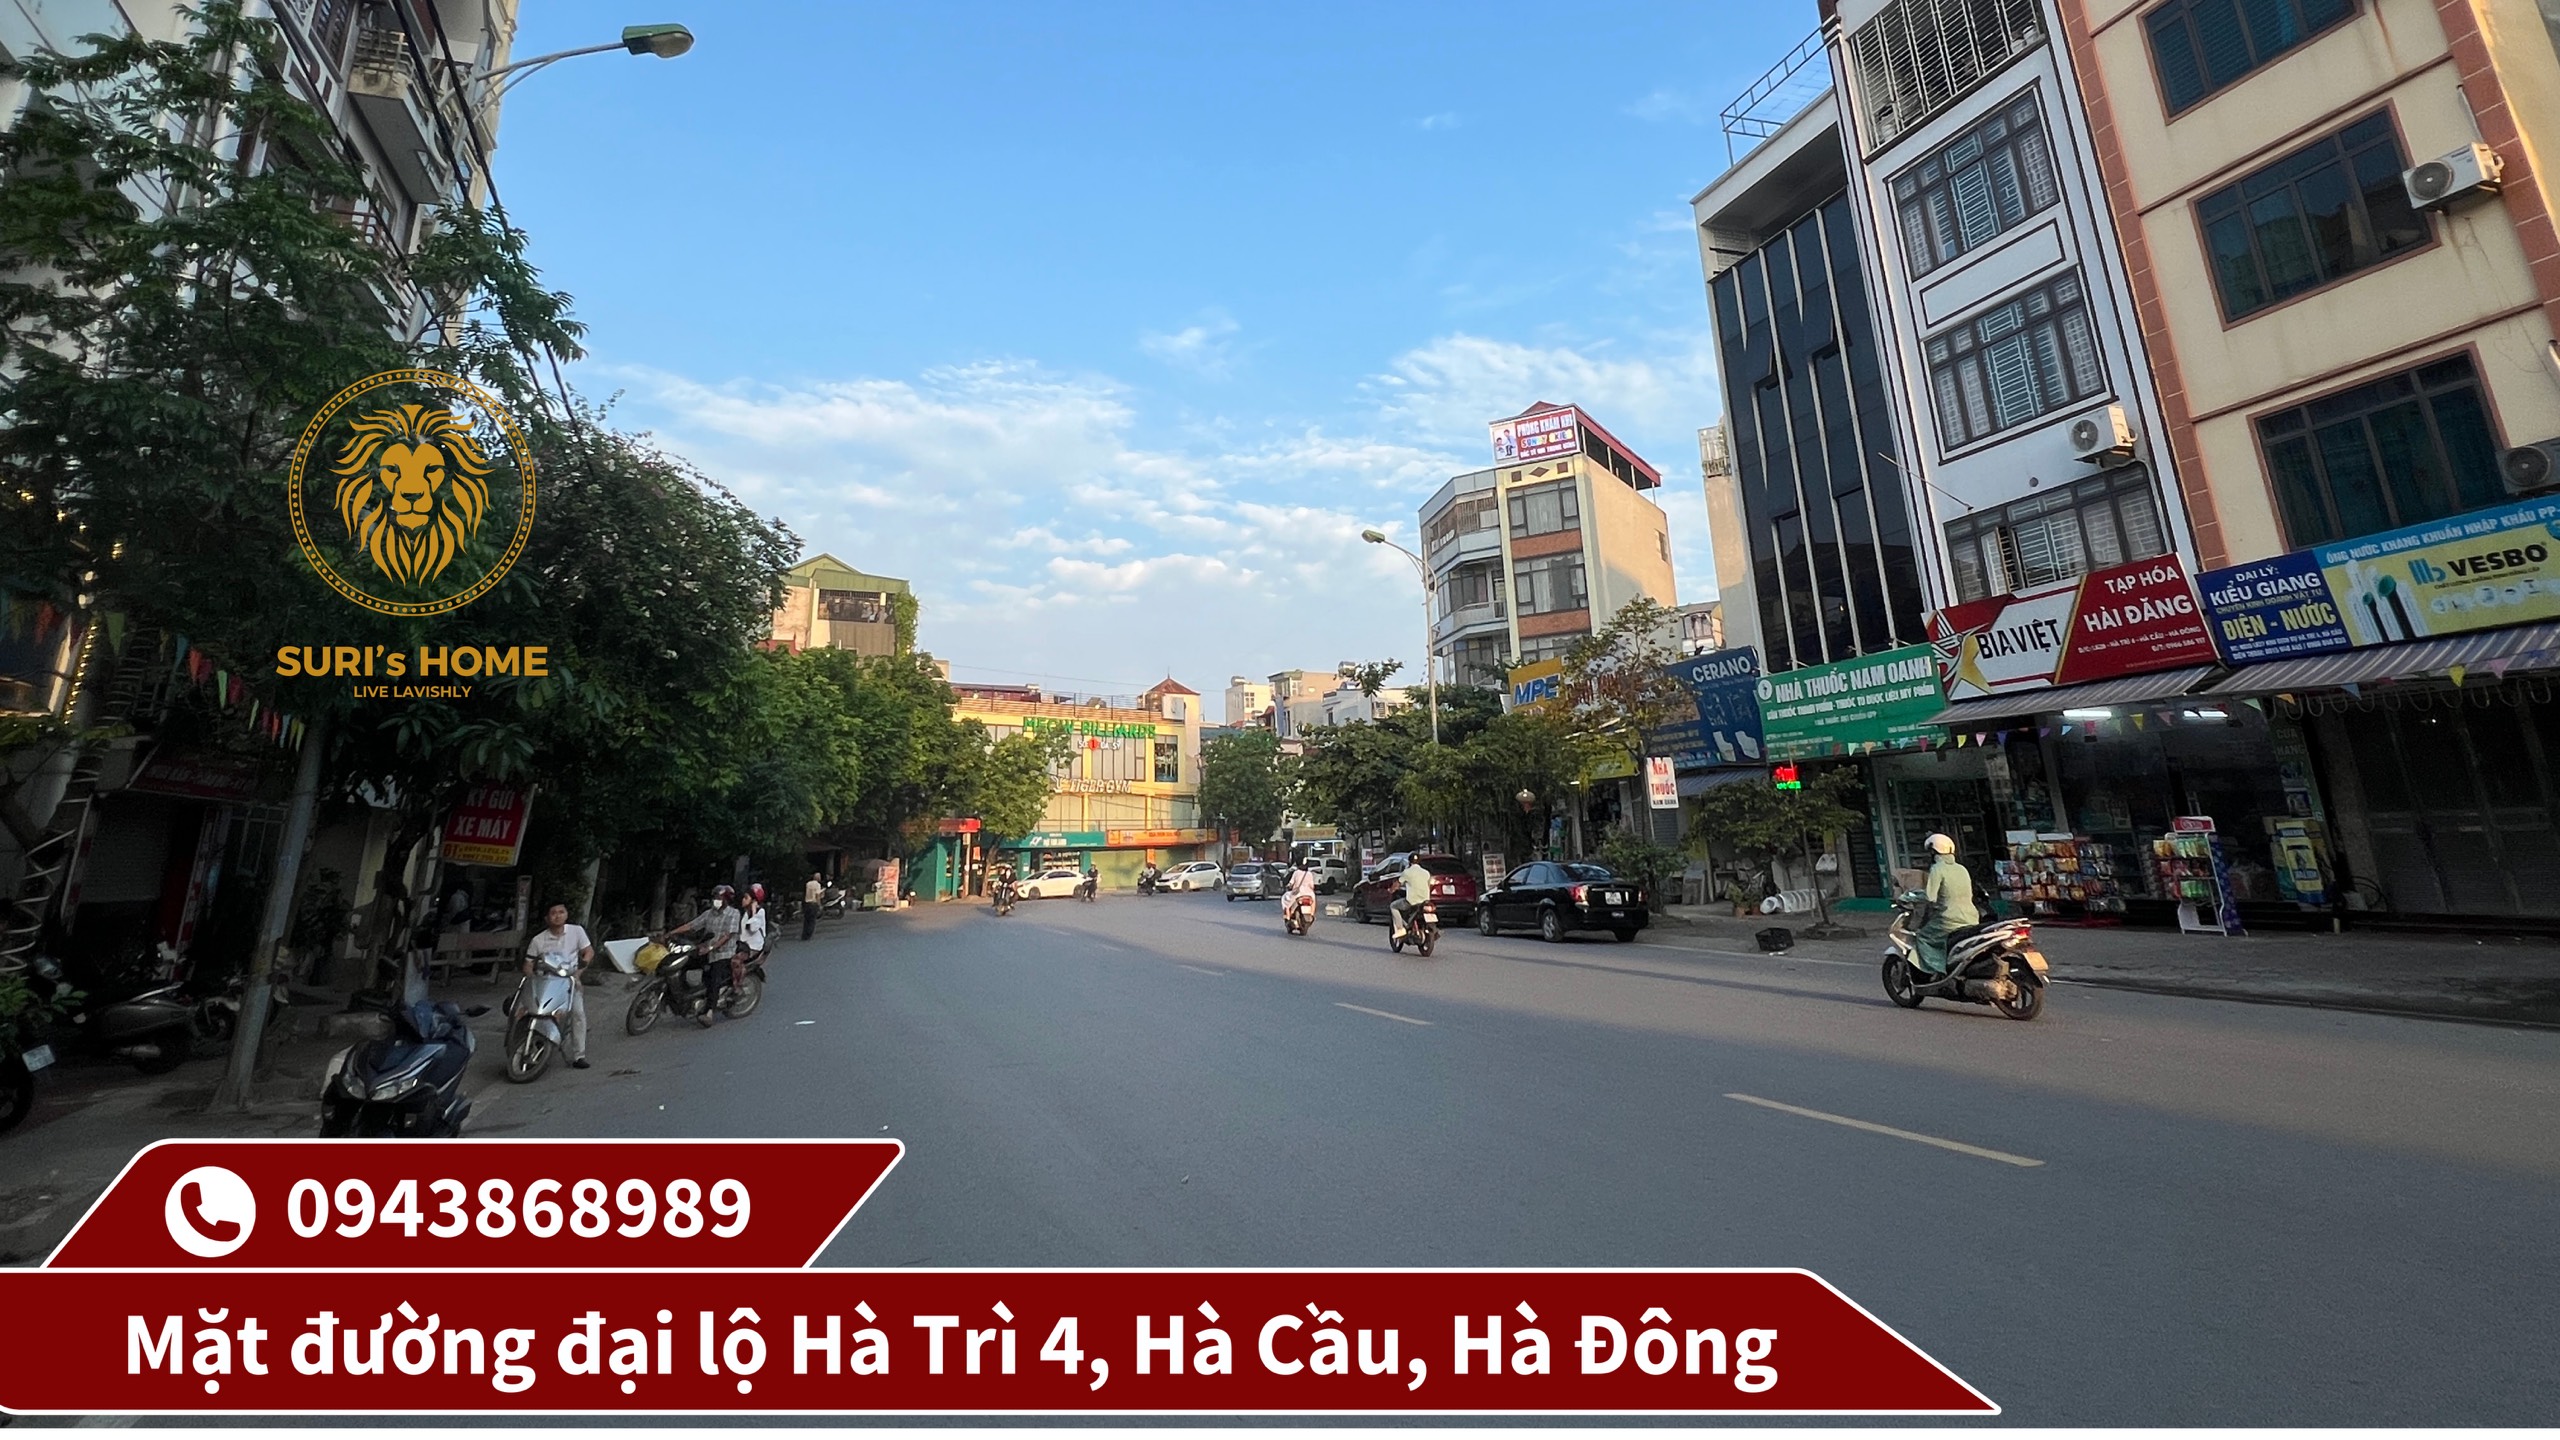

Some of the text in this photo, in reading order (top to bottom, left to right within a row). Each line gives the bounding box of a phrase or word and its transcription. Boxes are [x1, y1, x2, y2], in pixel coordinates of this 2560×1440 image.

[2350, 543, 2381, 560] NƯỚC
[2382, 533, 2421, 552] KHÁNG
[2421, 522, 2463, 544] KHUẨN
[2464, 518, 2499, 536] NHẬP
[2448, 544, 2548, 578] VESBO
[2104, 564, 2180, 595] TẠP HÓA
[2256, 572, 2322, 597] GIANG
[2125, 594, 2194, 625] ĐĂNG
[2265, 594, 2293, 606] DOANH
[2222, 614, 2268, 642] ĐIỆN
[2279, 598, 2336, 632] NƯỚC
[1692, 655, 1752, 684] CERANO
[1776, 676, 1804, 704] NHÀ
[1804, 667, 1848, 698] THUỐC
[1849, 664, 1886, 691] NAM
[1887, 656, 1933, 684] OANH
[1082, 720, 1156, 738] BILLIARDS
[1651, 779, 1676, 796] THUỐC
[453, 815, 513, 840] XE MÁY
